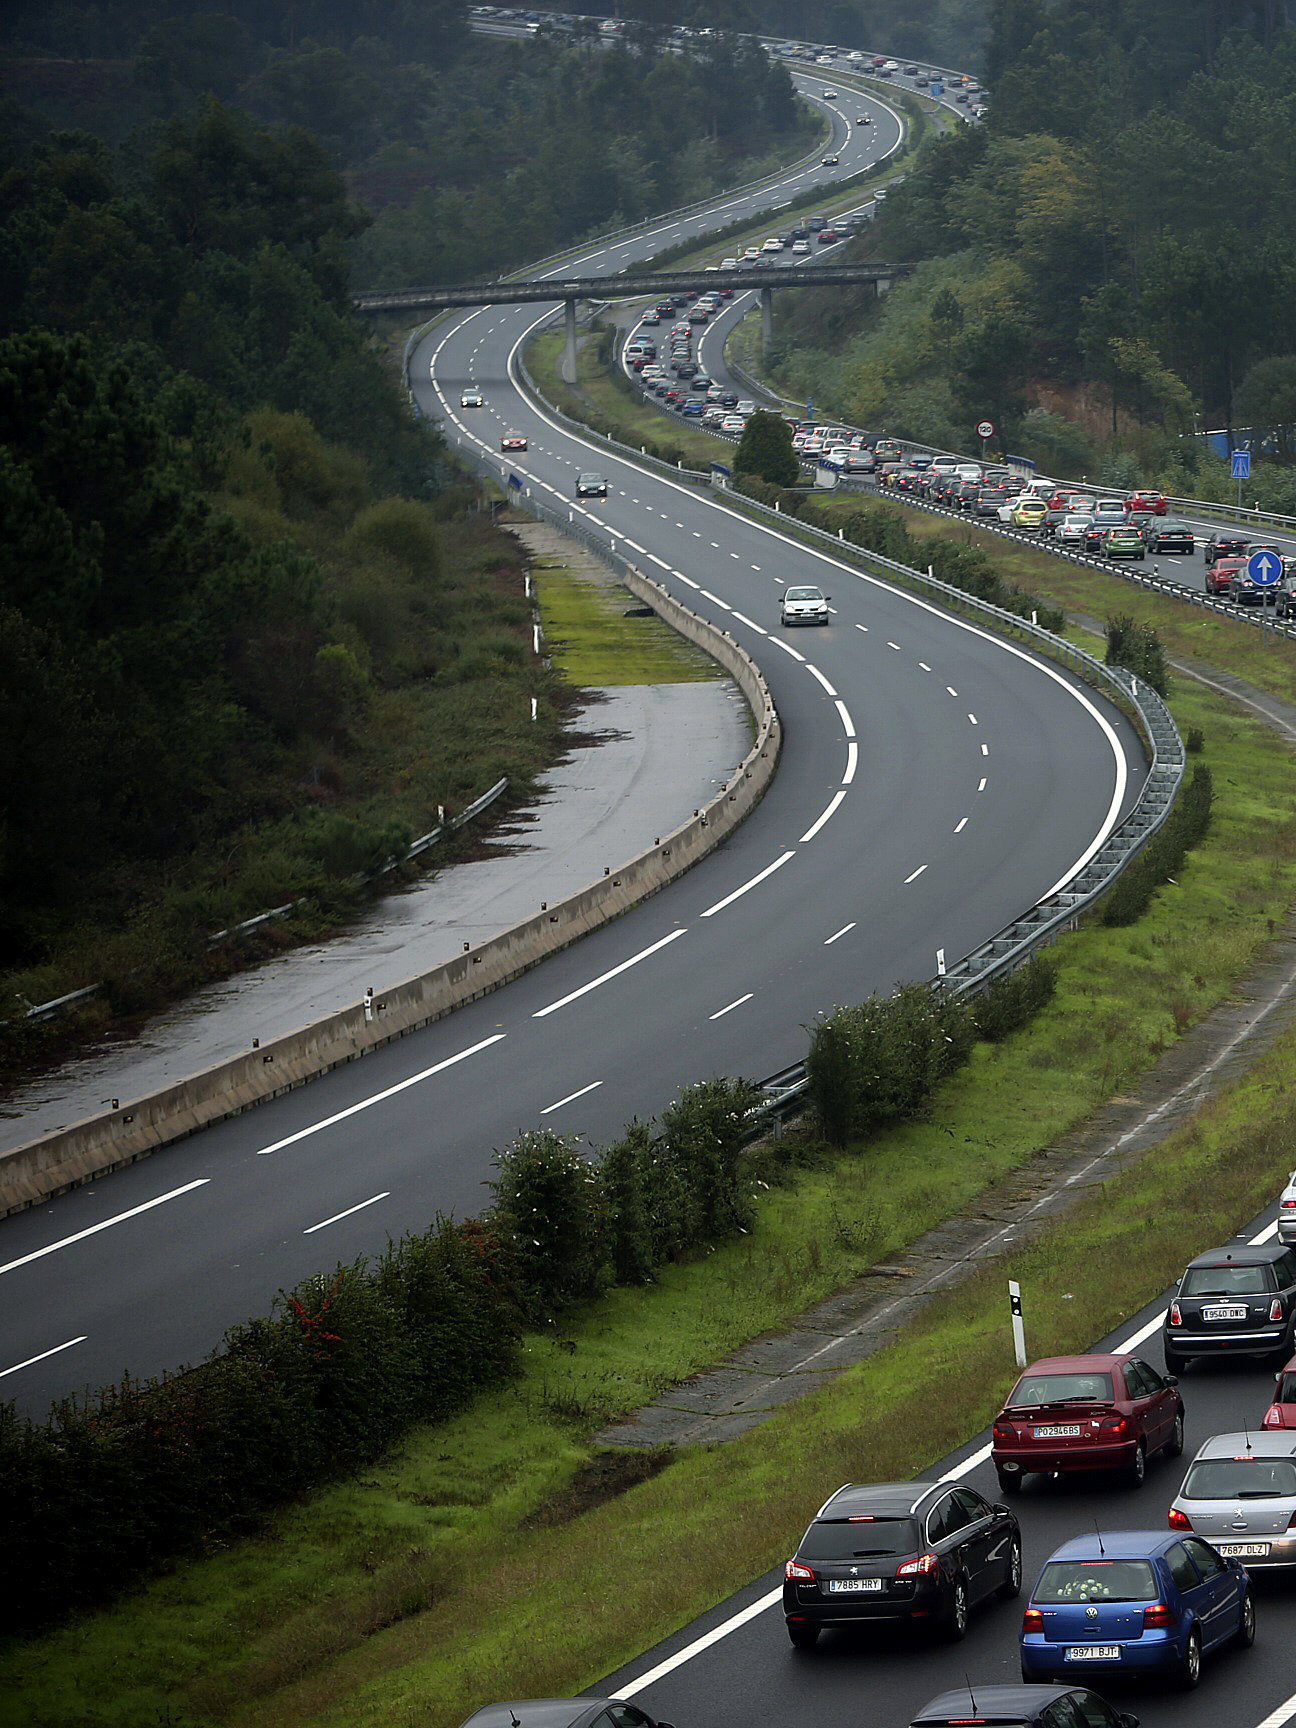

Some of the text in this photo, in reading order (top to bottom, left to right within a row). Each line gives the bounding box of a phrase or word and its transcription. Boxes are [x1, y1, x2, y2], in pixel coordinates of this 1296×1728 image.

[1209, 1310, 1227, 1318] 9540
[1222, 1545, 1263, 1555] 7687 DLZ
[837, 1579, 878, 1590] 7885 HRY
[1073, 1646, 1115, 1658] 9971 BJT
